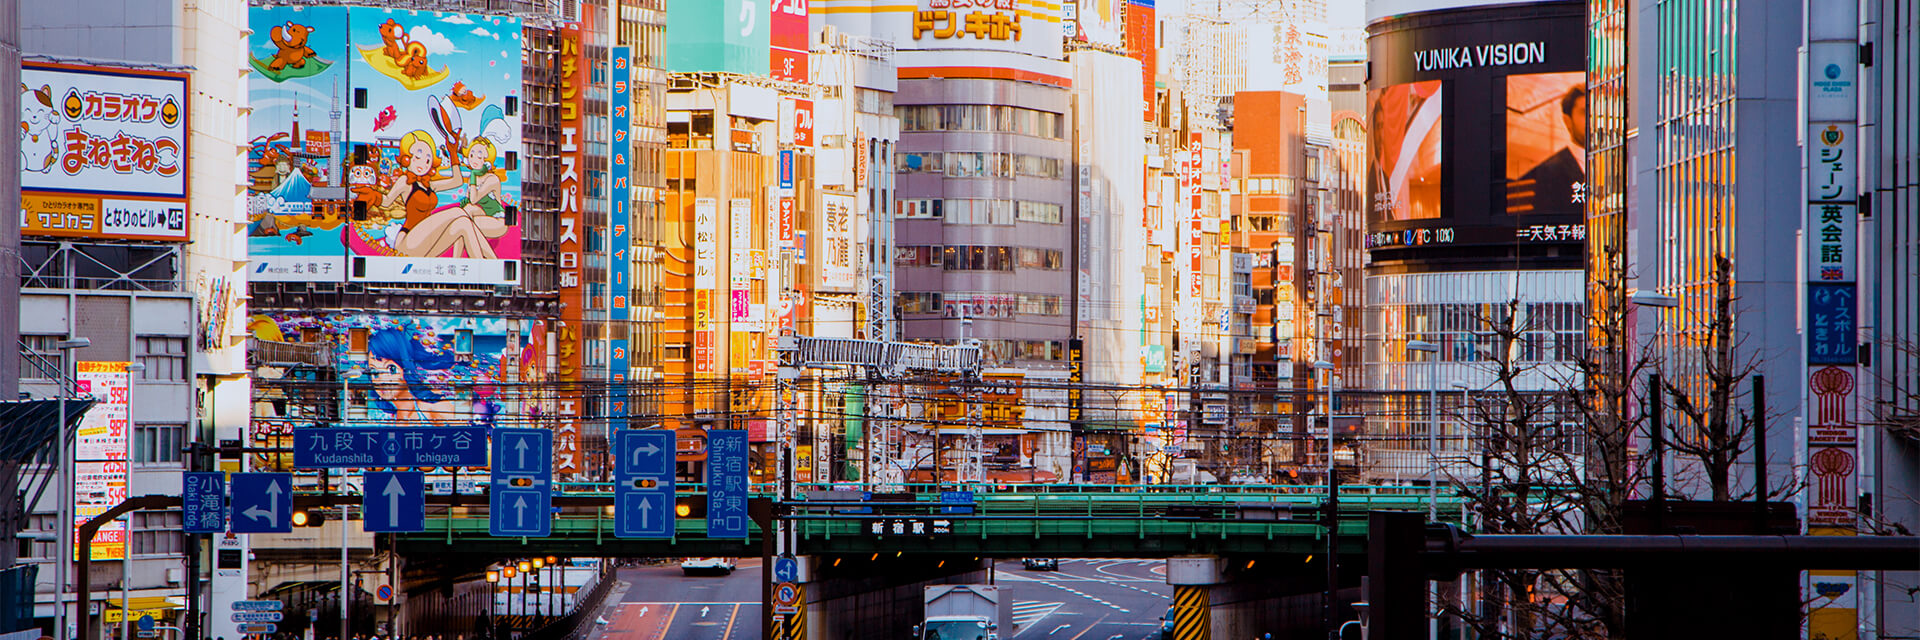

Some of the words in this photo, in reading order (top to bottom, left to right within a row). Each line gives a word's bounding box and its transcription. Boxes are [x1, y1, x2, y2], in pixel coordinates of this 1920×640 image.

[783, 57, 795, 76] 3F
[1414, 48, 1473, 71] YUNIKA
[1476, 42, 1545, 66] VISION
[562, 36, 578, 120] パチンコ
[84, 94, 159, 121] カラオケ
[62, 127, 180, 175] まねきねこ
[1192, 140, 1201, 196] カラオケ
[1821, 149, 1843, 200] シェーン
[42, 200, 95, 211] ひとりカラオケ専門店
[104, 208, 157, 228] となりのビル
[168, 208, 183, 230] 4F
[560, 127, 579, 287] エスパス日拓
[37, 212, 94, 230] ワンカラ
[782, 209, 791, 239] アイフル
[1820, 205, 1843, 263] 英会話
[697, 213, 708, 277] 小松ビル
[292, 262, 333, 275] 北電子
[435, 264, 469, 276] 北電子
[309, 432, 379, 451] 九段下
[314, 453, 374, 464] Kudanshita
[416, 453, 460, 464] Ichigaya
[711, 438, 724, 486] Shinjuku
[187, 475, 198, 501] Otaki
[725, 435, 743, 531] 新宿駅東口
[200, 476, 220, 529] 小滝橋
[187, 504, 198, 529] Brdg.
[871, 519, 924, 534] 新宿駅
